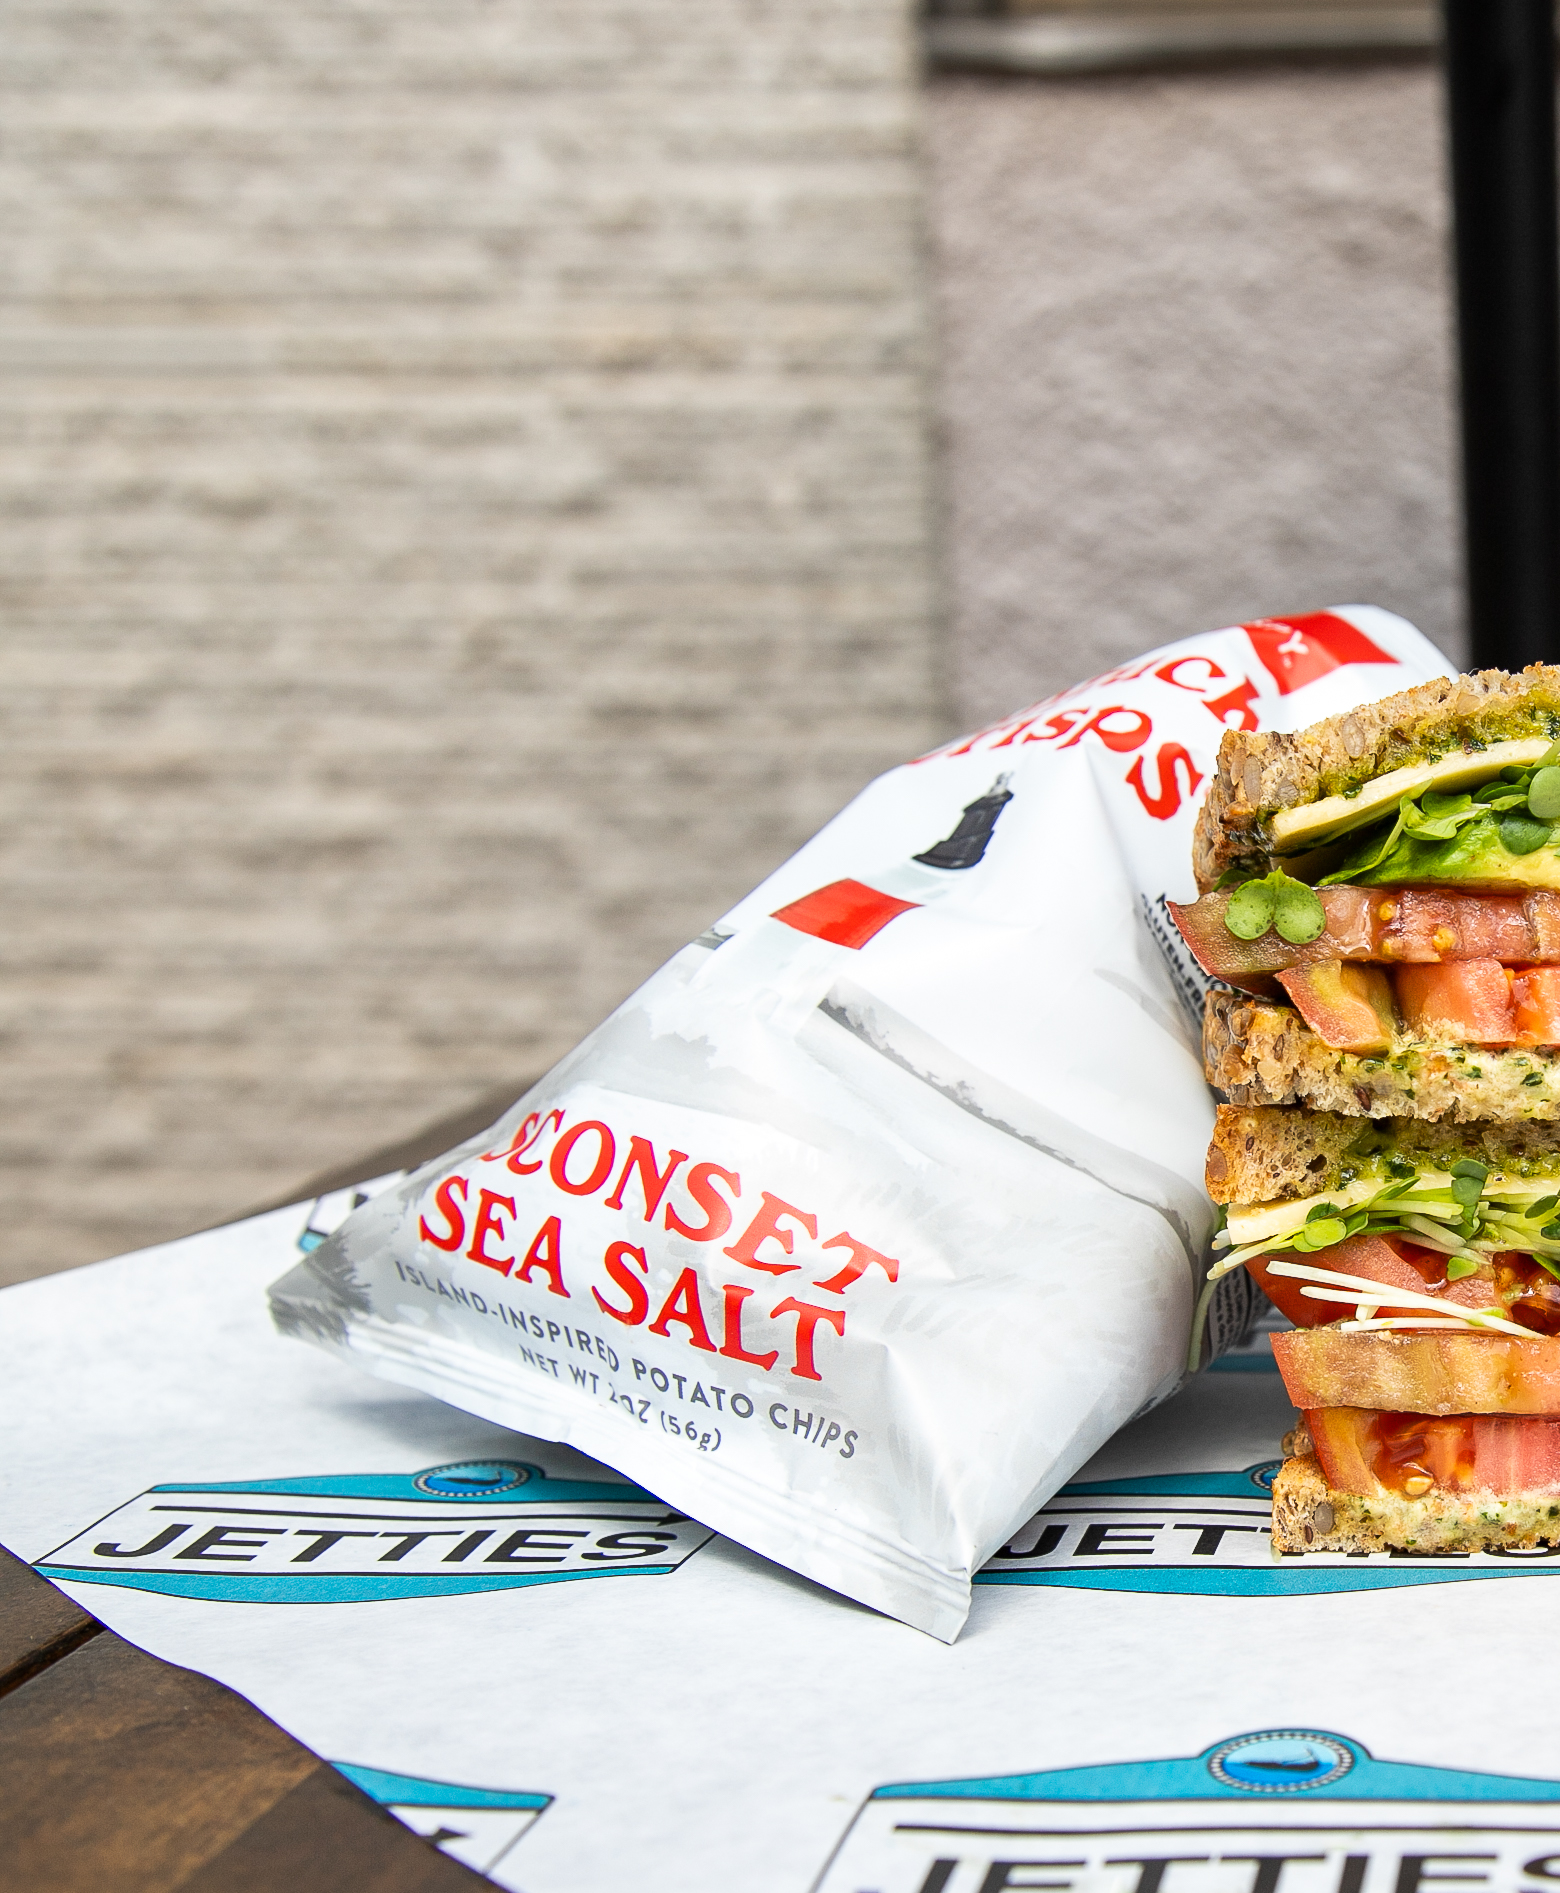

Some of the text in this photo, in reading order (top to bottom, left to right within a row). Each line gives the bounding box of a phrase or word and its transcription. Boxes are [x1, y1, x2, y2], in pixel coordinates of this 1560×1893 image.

[420, 1175, 846, 1381] SEA SALT
[395, 1260, 859, 1459] ISLAND-INSPIRED POTATO CHIPS
[519, 1344, 559, 1378] NET
[569, 1364, 600, 1394] WT
[661, 1410, 722, 1452] (56g)
[93, 1523, 679, 1565] JETTIES
